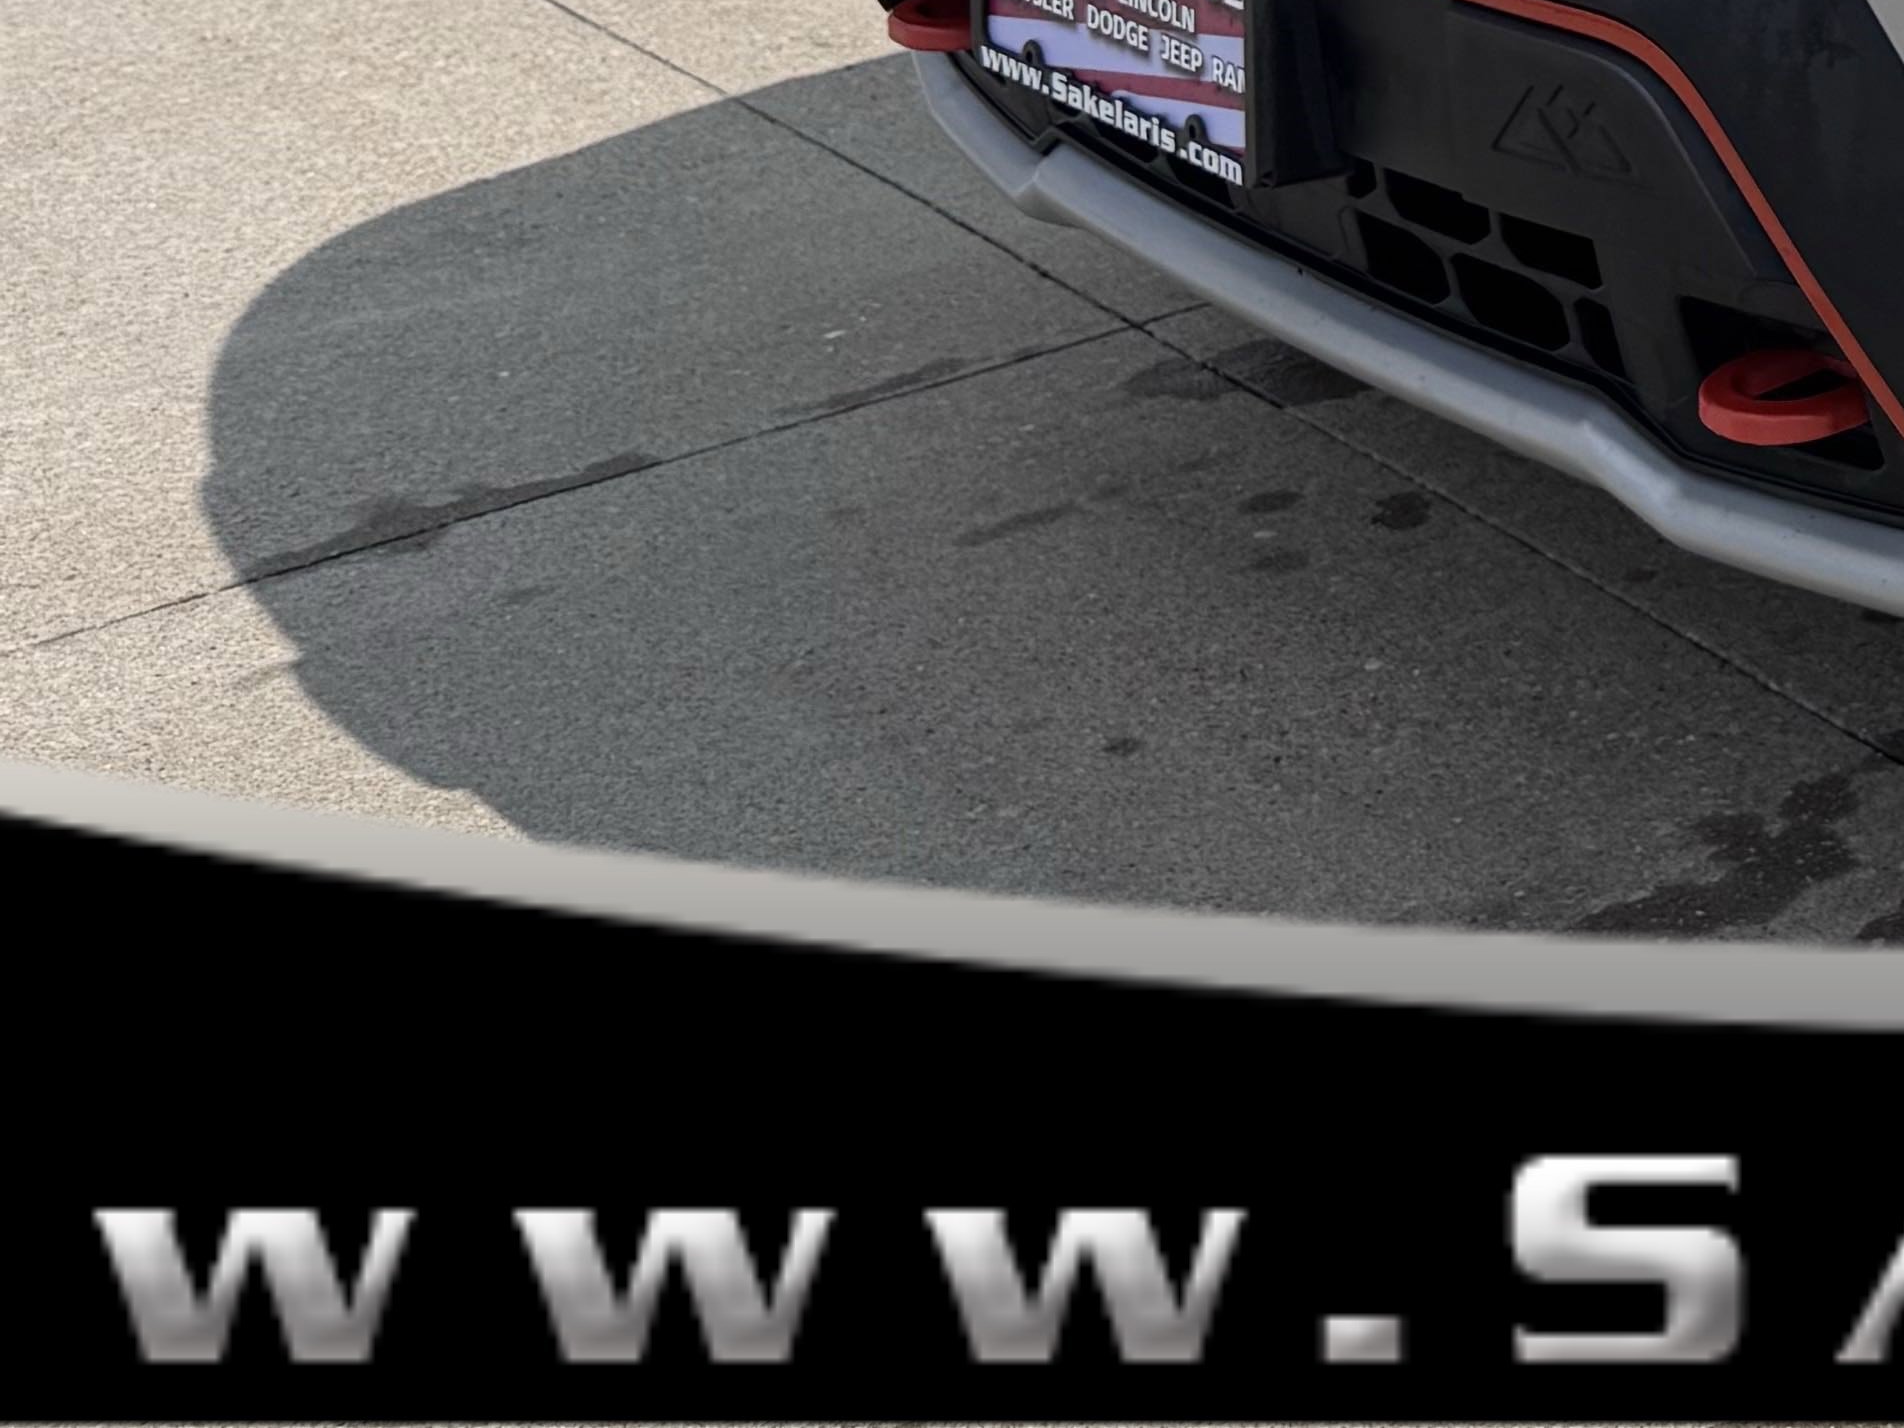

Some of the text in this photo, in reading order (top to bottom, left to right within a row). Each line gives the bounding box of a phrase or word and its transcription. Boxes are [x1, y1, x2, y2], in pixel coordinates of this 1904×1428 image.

[1086, 3, 1149, 52] DODGE
[1161, 34, 1203, 73] JEEP
[980, 45, 1243, 187] www.Sakelaris.com
